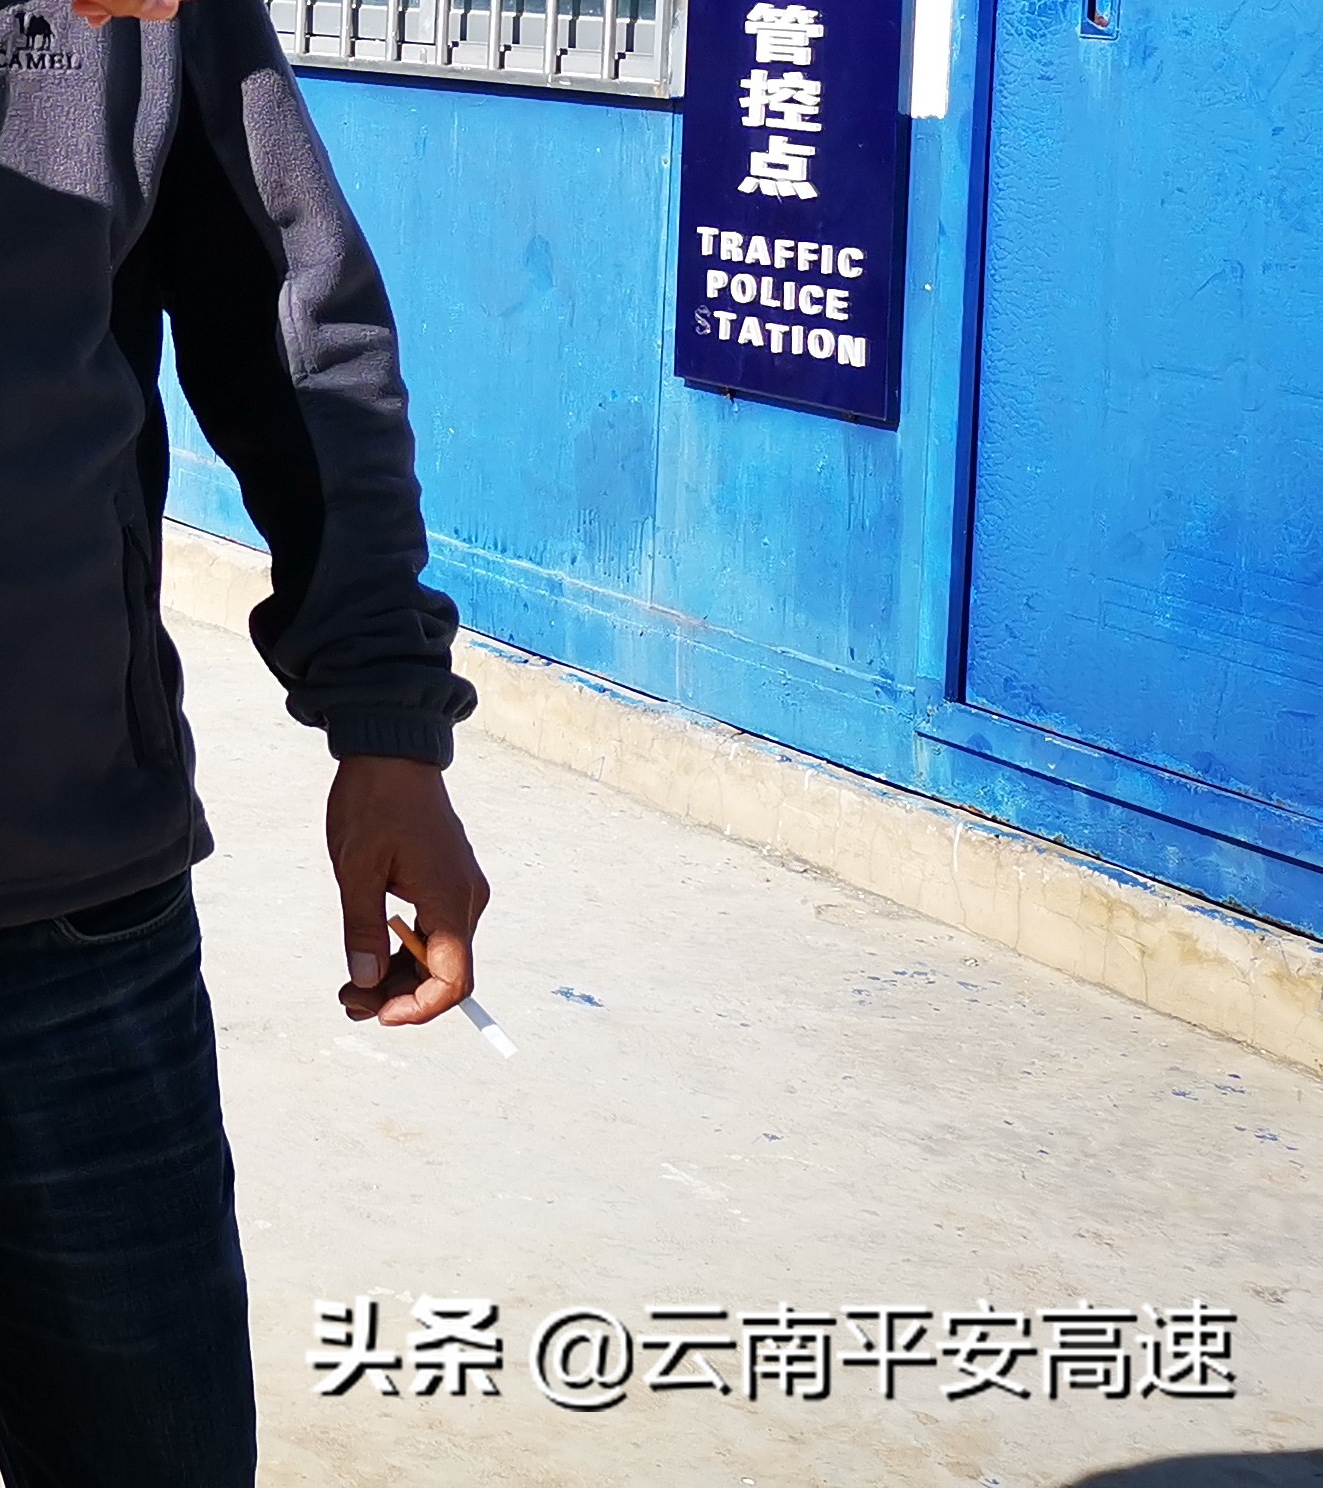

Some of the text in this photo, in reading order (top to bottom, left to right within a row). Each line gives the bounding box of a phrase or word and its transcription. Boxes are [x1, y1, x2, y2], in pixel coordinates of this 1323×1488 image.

[696, 226, 864, 279] TRAFFIC
[706, 269, 851, 321] POLICE
[695, 304, 867, 368] STATION
